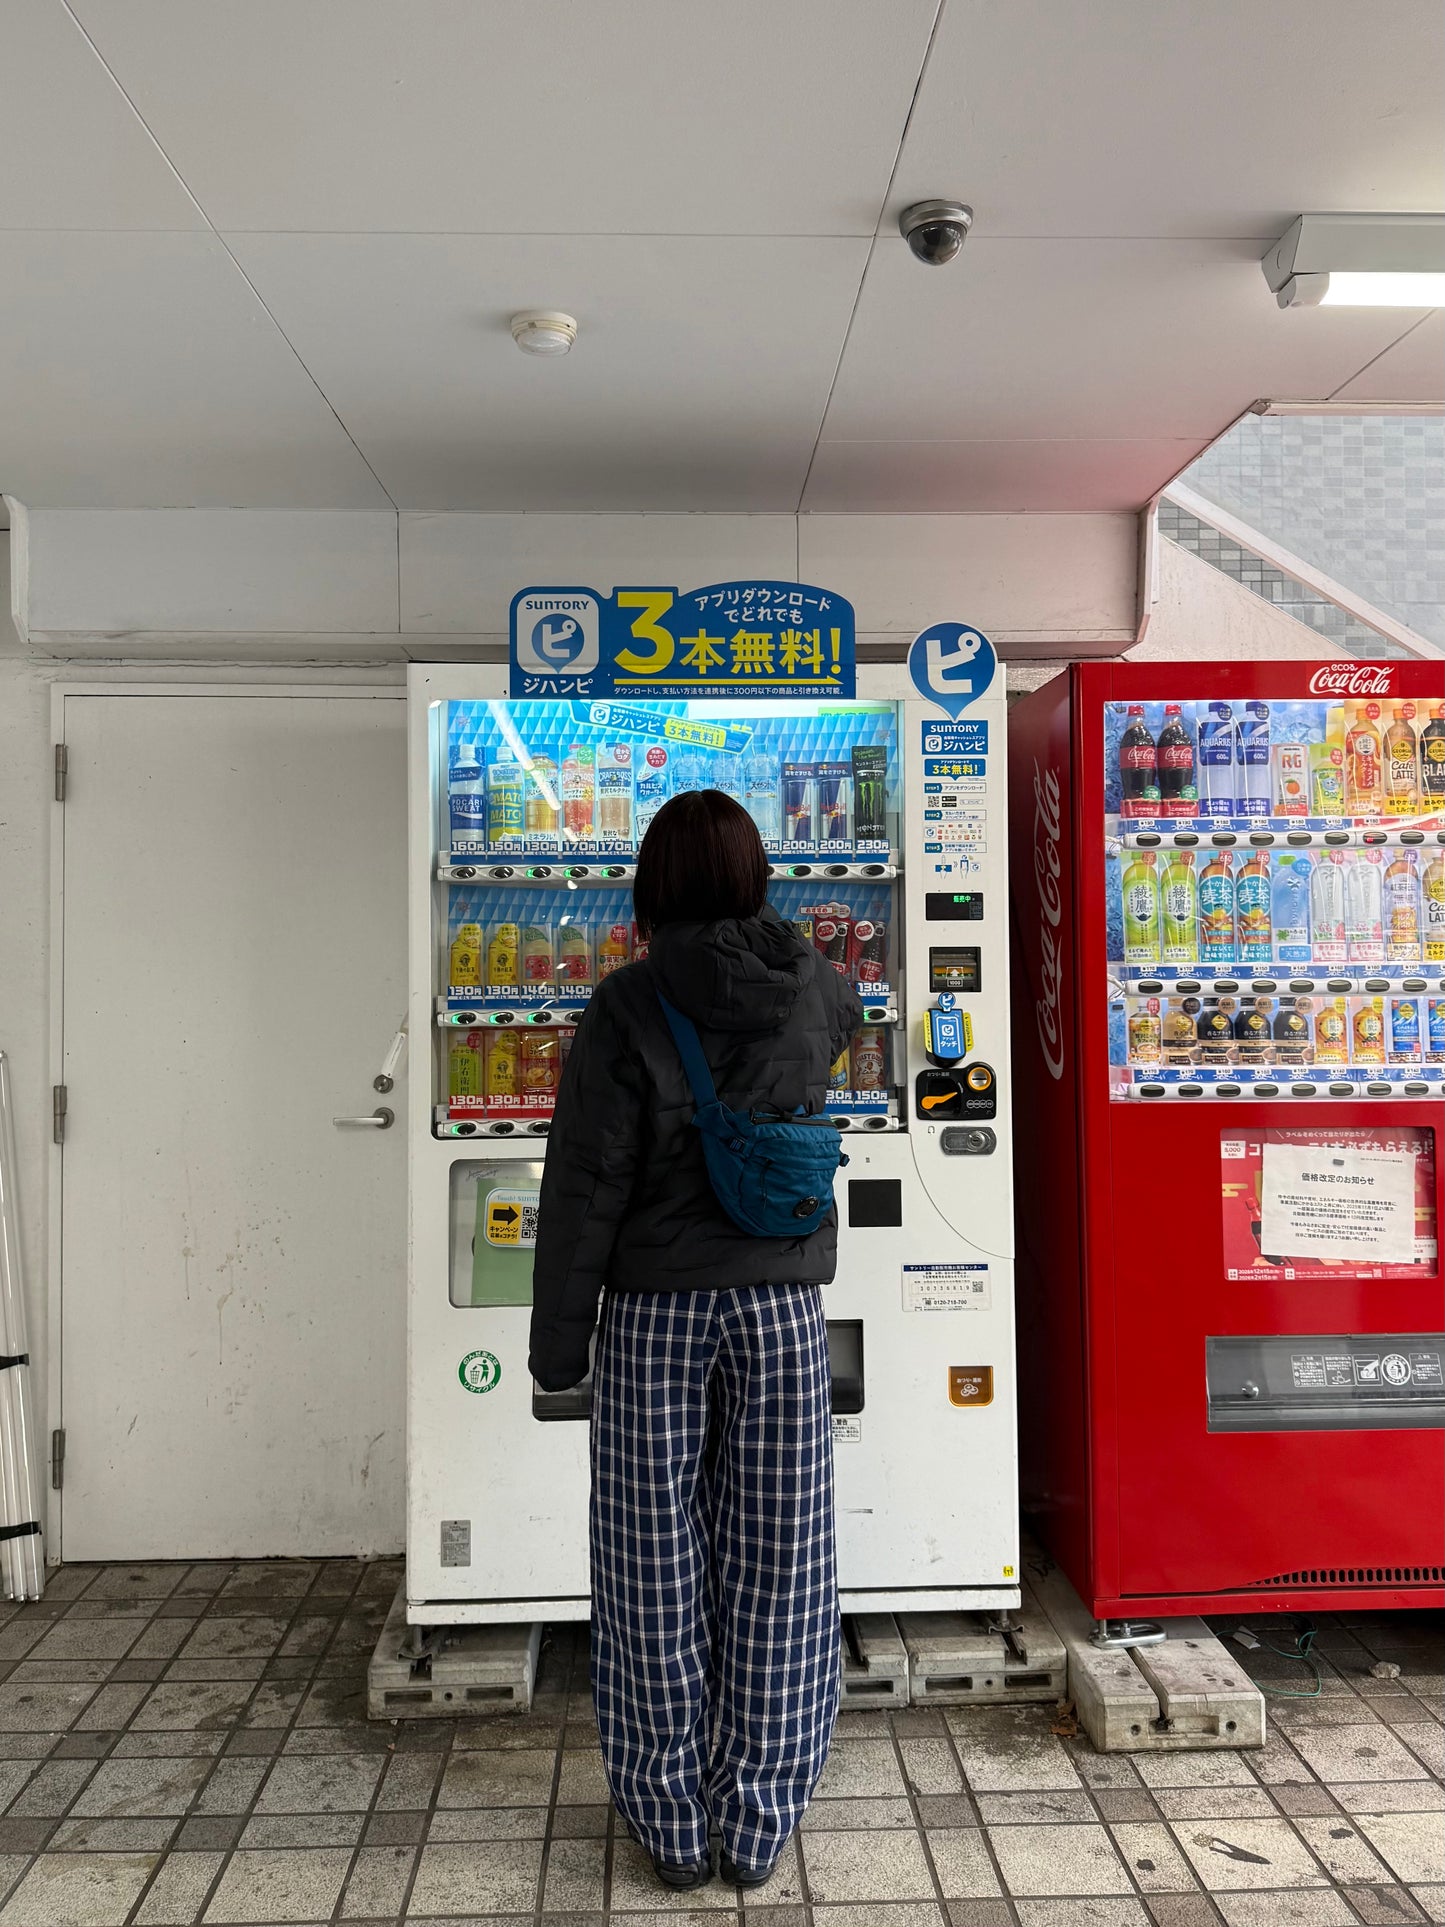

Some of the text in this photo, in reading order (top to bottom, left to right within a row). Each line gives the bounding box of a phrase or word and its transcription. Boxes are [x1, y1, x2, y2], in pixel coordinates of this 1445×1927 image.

[526, 600, 589, 610] SUNTORY
[694, 589, 832, 613] アプリダウンロード
[724, 607, 804, 625] でどれでも
[542, 619, 576, 658] ピ
[926, 632, 981, 694] ピ
[1309, 666, 1395, 695] Coca-Cola
[523, 678, 594, 694] ジハンピ
[611, 715, 660, 733] ジハンピ
[930, 725, 979, 733] SUNTORY
[669, 725, 721, 745] 3本無料!
[943, 741, 985, 751] ジハンピ
[1200, 738, 1231, 747] AQUARIUS
[1237, 738, 1269, 747] AQUARIUS
[932, 764, 978, 775] 3本無料!
[1391, 770, 1415, 780] LATTE
[452, 842, 485, 851] 160円
[488, 842, 522, 851] 150円
[526, 842, 558, 851] 130円
[564, 842, 596, 851] 170円
[600, 842, 632, 851] 170円
[782, 841, 815, 850] 200円
[820, 841, 851, 850] 200円
[857, 841, 889, 850] 230円
[1134, 885, 1149, 912] 綾鷹
[1172, 885, 1187, 912] 綾鷹
[1202, 888, 1233, 904] 麦茶
[1238, 888, 1270, 904] 麦茶
[1033, 756, 1064, 1080] Coca-Cola
[450, 986, 482, 995] 130円
[487, 986, 519, 995] 130円
[522, 985, 556, 995] 140円
[559, 985, 593, 995] 140円
[858, 982, 889, 992] 130円
[942, 994, 953, 1006] ピ
[451, 1095, 483, 1105] 130円
[489, 1095, 521, 1105] 130円
[522, 1095, 556, 1105] 150円
[856, 1090, 888, 1100] 150円
[1301, 1172, 1375, 1186] 価格改定のお知らせ
[463, 1350, 499, 1366] のんだあとは
[463, 1381, 496, 1393] リサイクル
